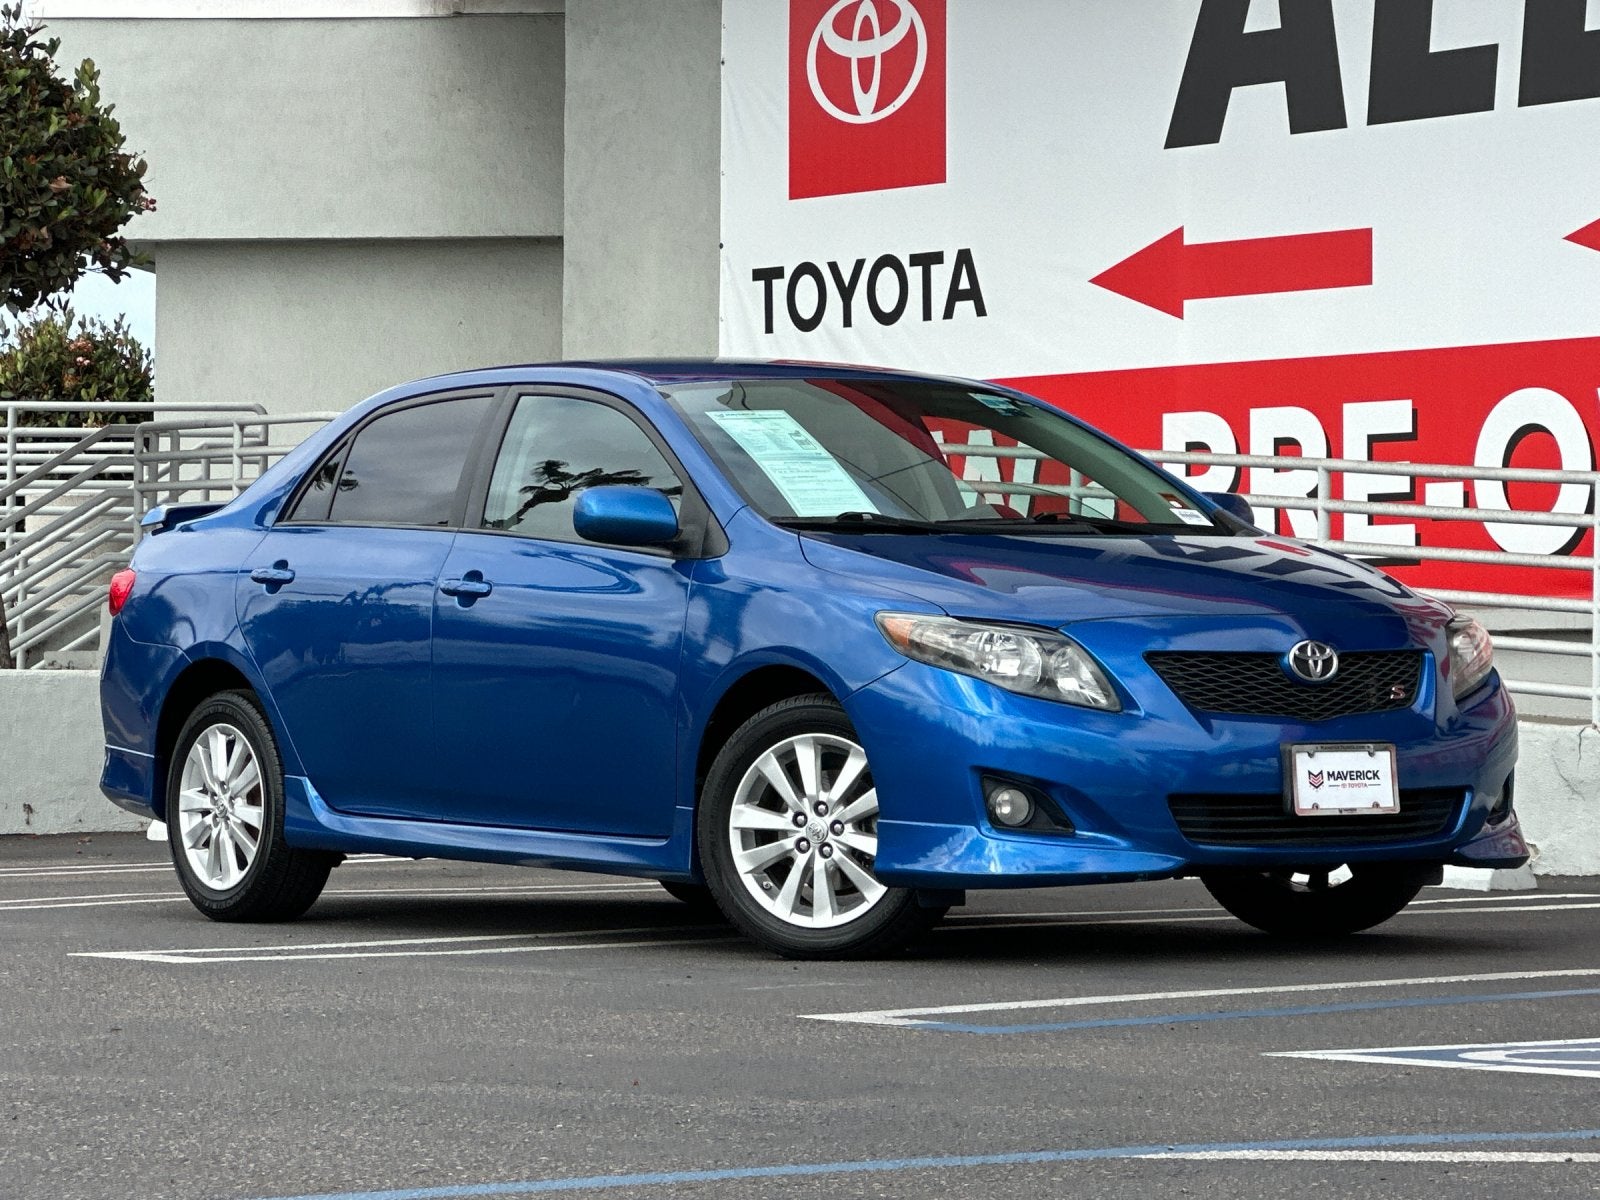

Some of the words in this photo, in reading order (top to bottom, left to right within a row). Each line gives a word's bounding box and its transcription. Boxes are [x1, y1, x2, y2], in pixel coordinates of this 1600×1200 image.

[752, 248, 988, 334] TOYOTA
[1162, 387, 1600, 560] PRE-O
[1327, 769, 1381, 781] MAVERICK
